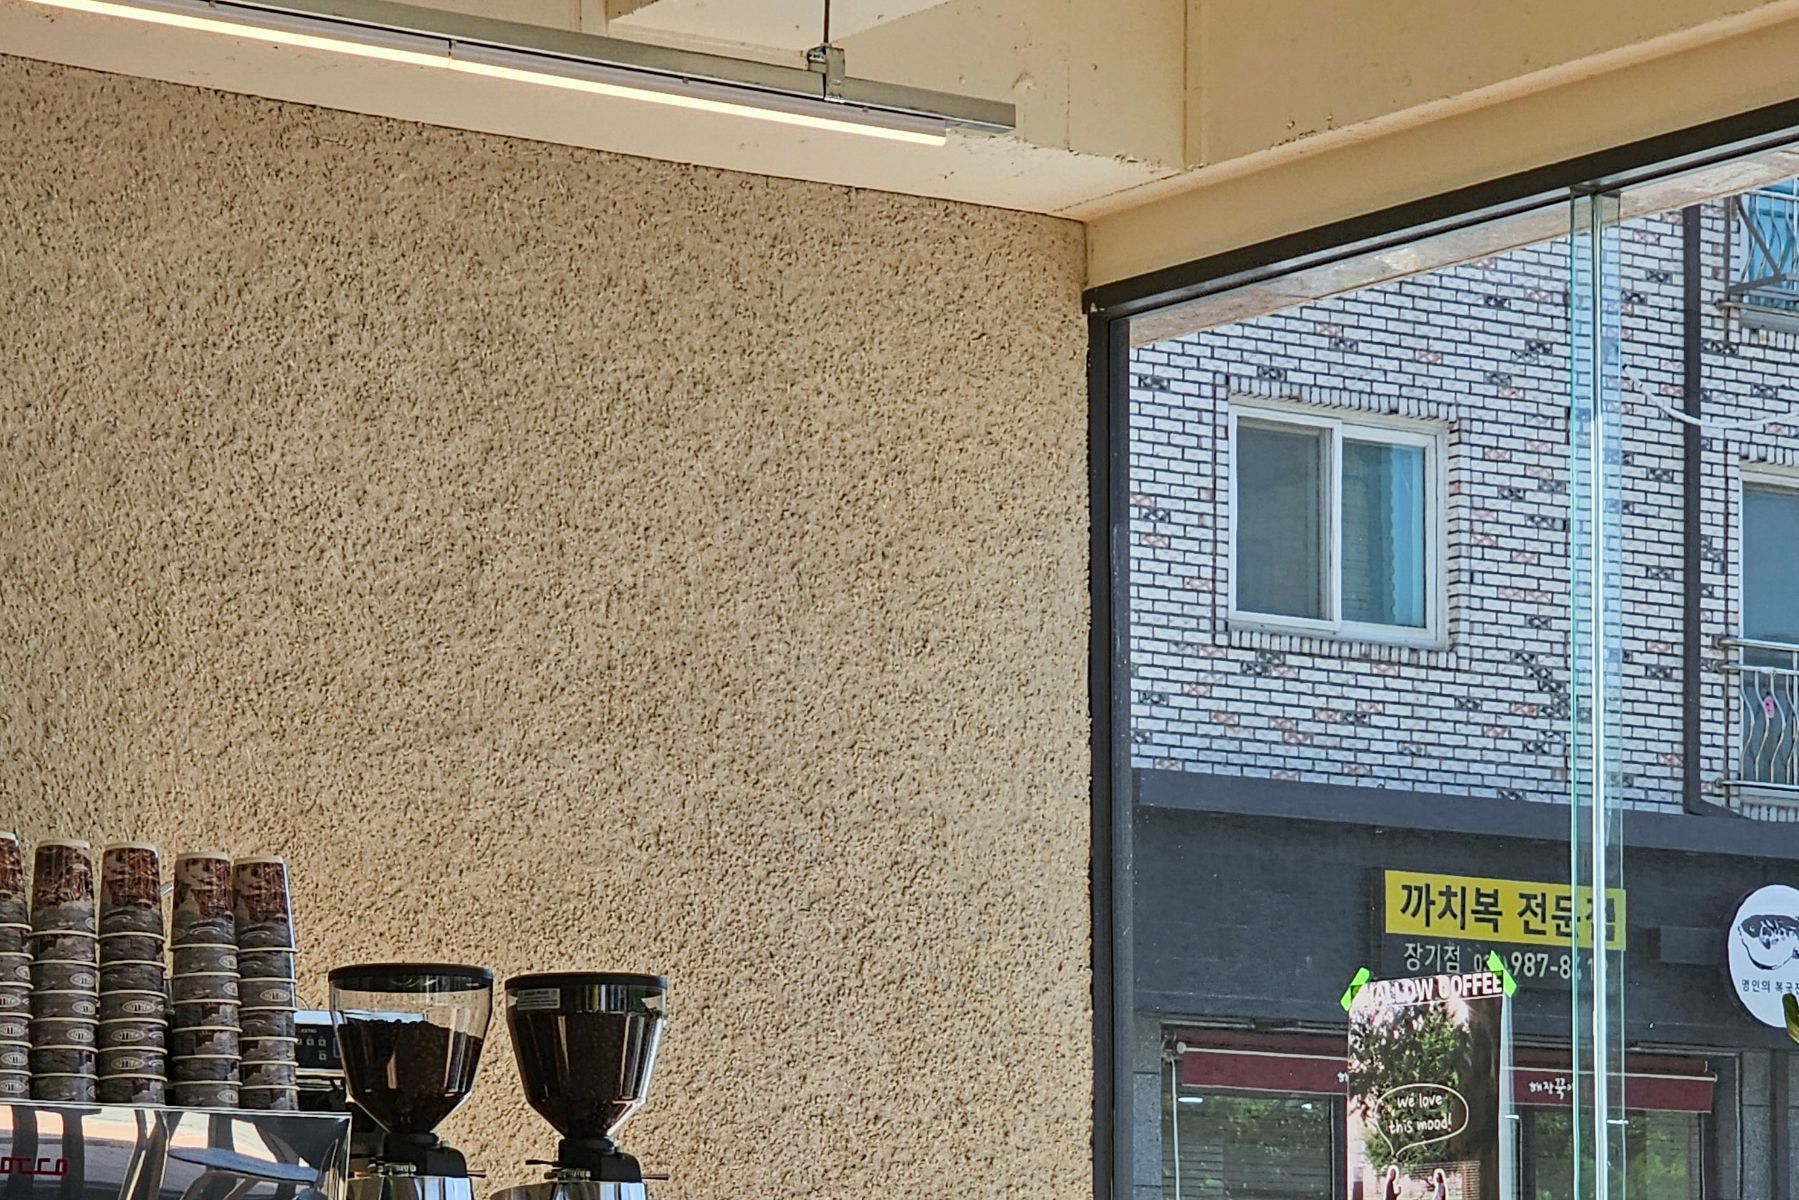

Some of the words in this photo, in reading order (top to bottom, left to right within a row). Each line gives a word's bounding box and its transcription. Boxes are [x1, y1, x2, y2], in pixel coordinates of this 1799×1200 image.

[1400, 883, 1503, 932] 까치복
[1403, 942, 1460, 974] 장기점
[1741, 979, 1770, 993] 명인의
[1397, 1095, 1415, 1108] we
[1419, 1092, 1442, 1109] love
[1389, 1119, 1413, 1134] this
[1416, 1112, 1452, 1132] mood!
